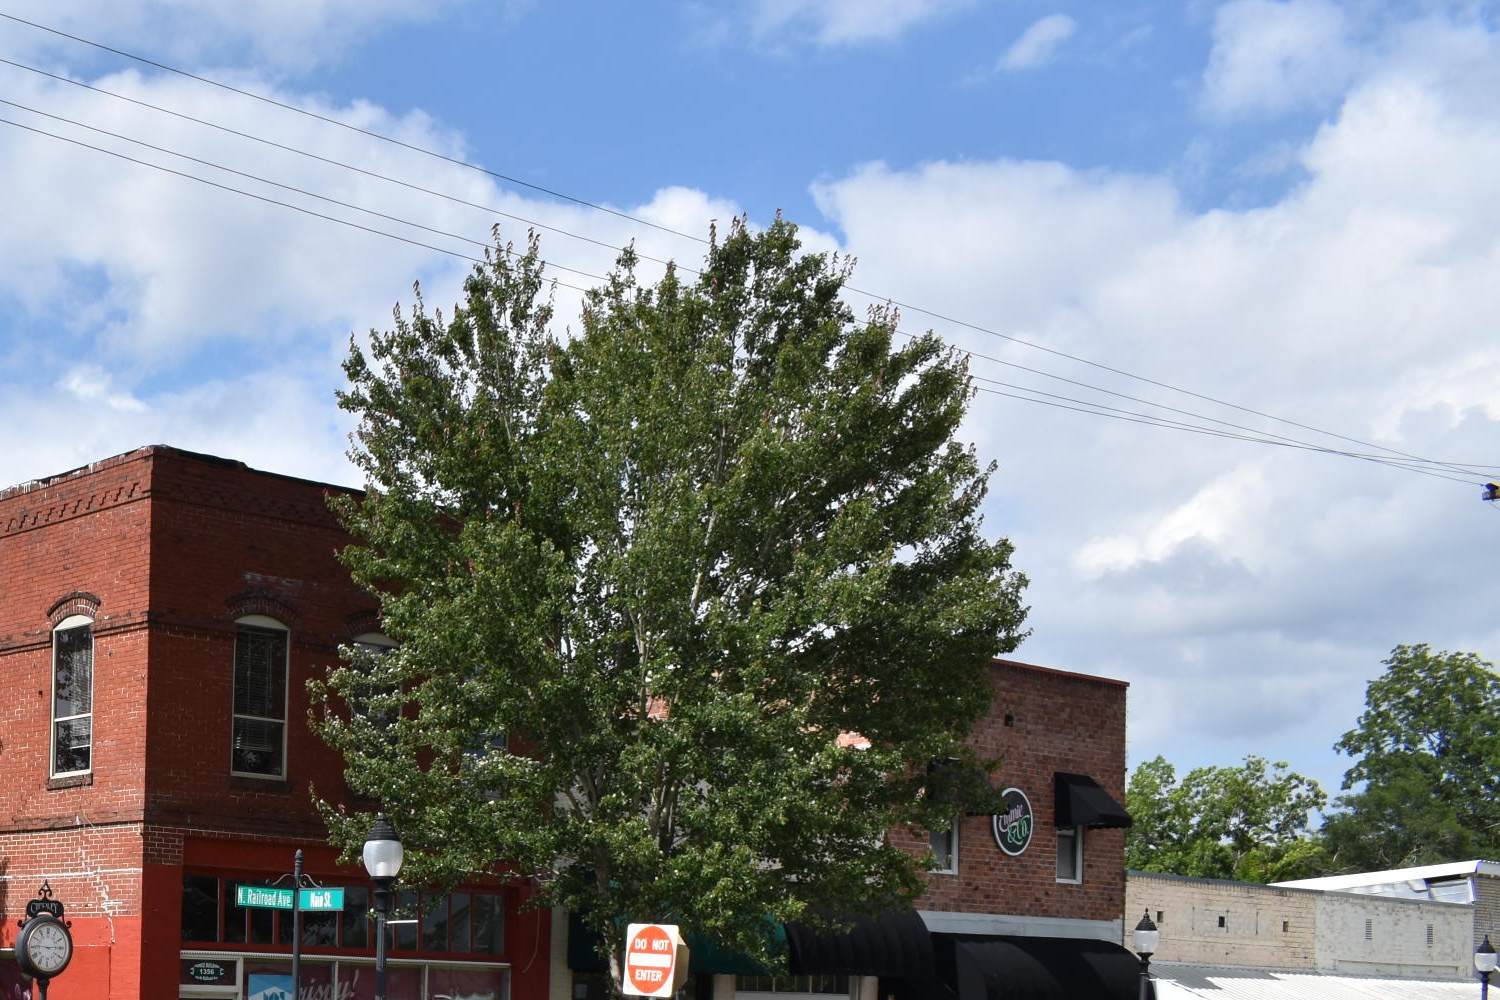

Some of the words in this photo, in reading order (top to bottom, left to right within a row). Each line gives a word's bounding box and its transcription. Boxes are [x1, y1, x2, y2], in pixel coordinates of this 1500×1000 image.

[238, 887, 246, 904] N.
[248, 888, 276, 906] Railroad
[278, 891, 293, 907] Ave.
[310, 892, 324, 907] Main
[324, 892, 332, 907] St.
[635, 938, 647, 950] DO
[652, 939, 669, 951] NOT
[635, 969, 662, 982] ENTER
